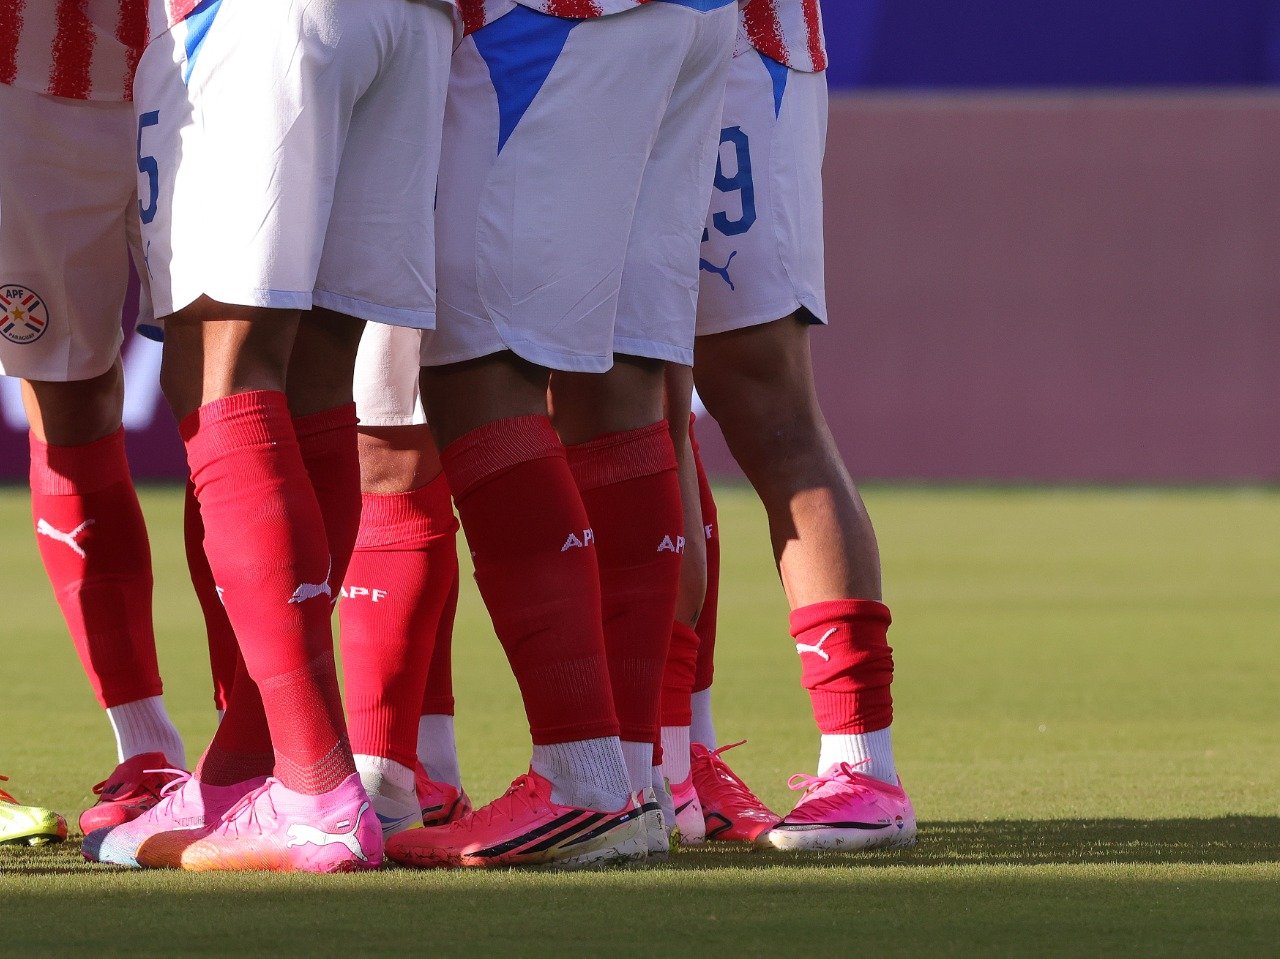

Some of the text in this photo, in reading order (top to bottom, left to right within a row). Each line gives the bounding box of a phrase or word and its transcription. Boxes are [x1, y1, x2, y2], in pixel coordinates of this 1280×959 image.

[712, 125, 757, 236] 9
[5, 289, 24, 299] APF
[8, 332, 36, 341] PARAGUAY
